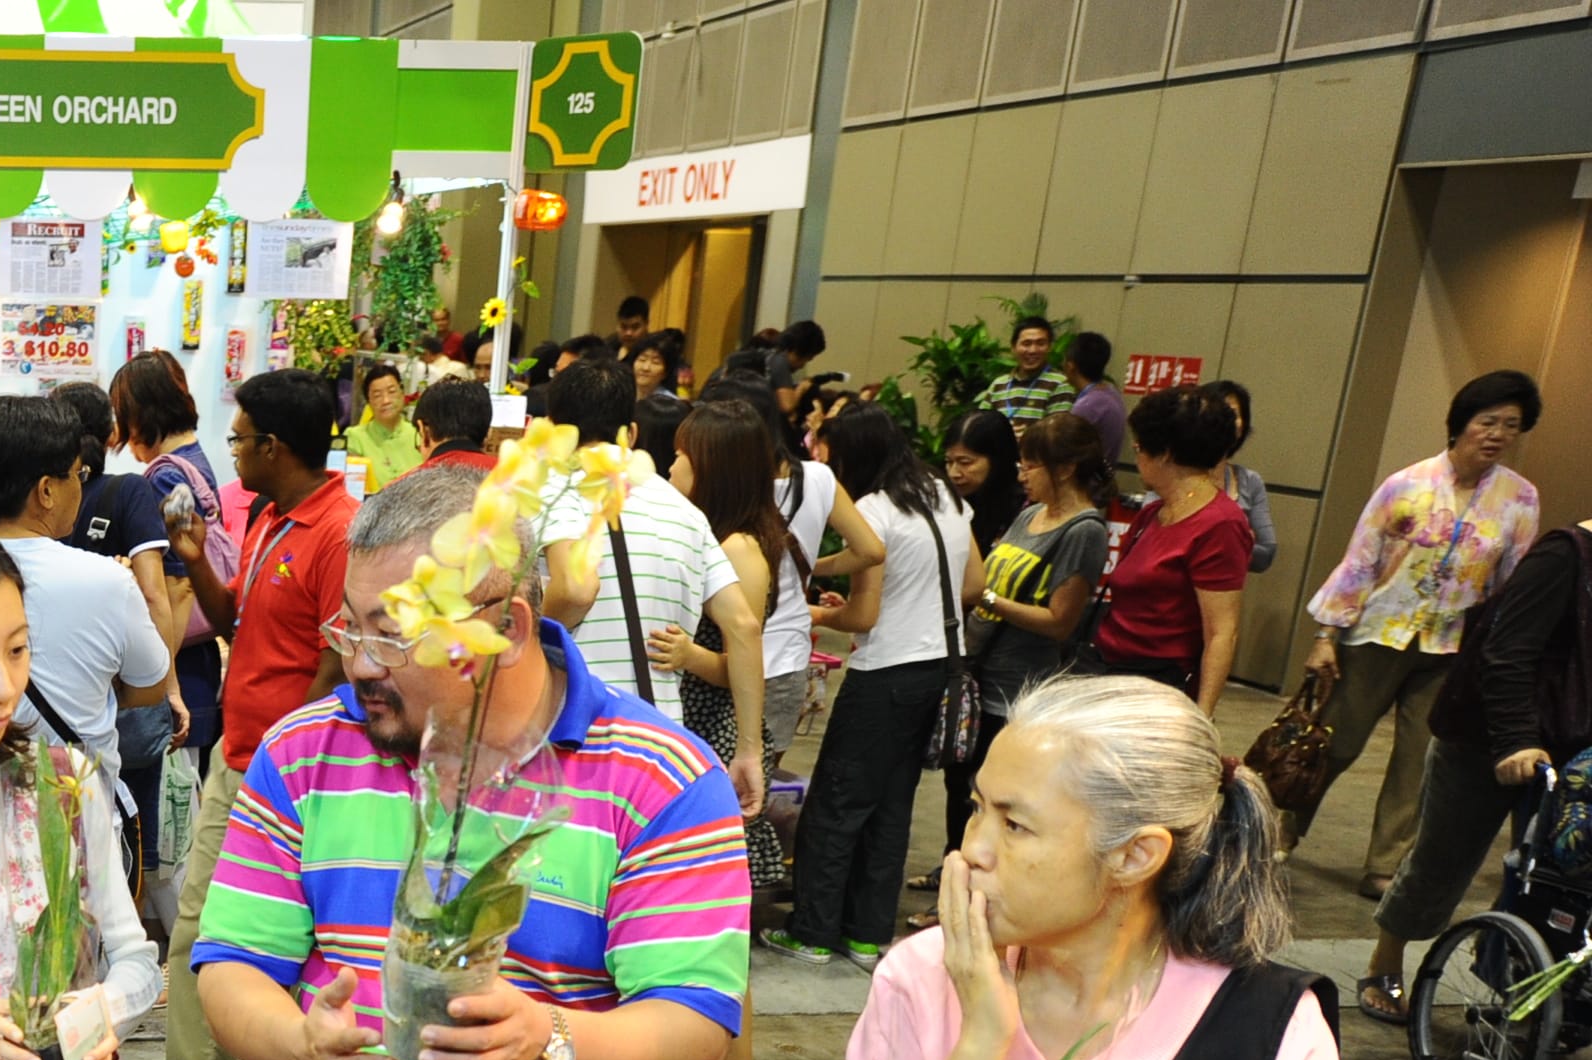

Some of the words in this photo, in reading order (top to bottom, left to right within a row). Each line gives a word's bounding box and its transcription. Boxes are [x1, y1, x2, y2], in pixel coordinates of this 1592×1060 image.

[52, 95, 178, 125] ORCHARD
[567, 91, 595, 115] 125
[637, 167, 679, 208] EXIT
[683, 159, 736, 204] ONLY
